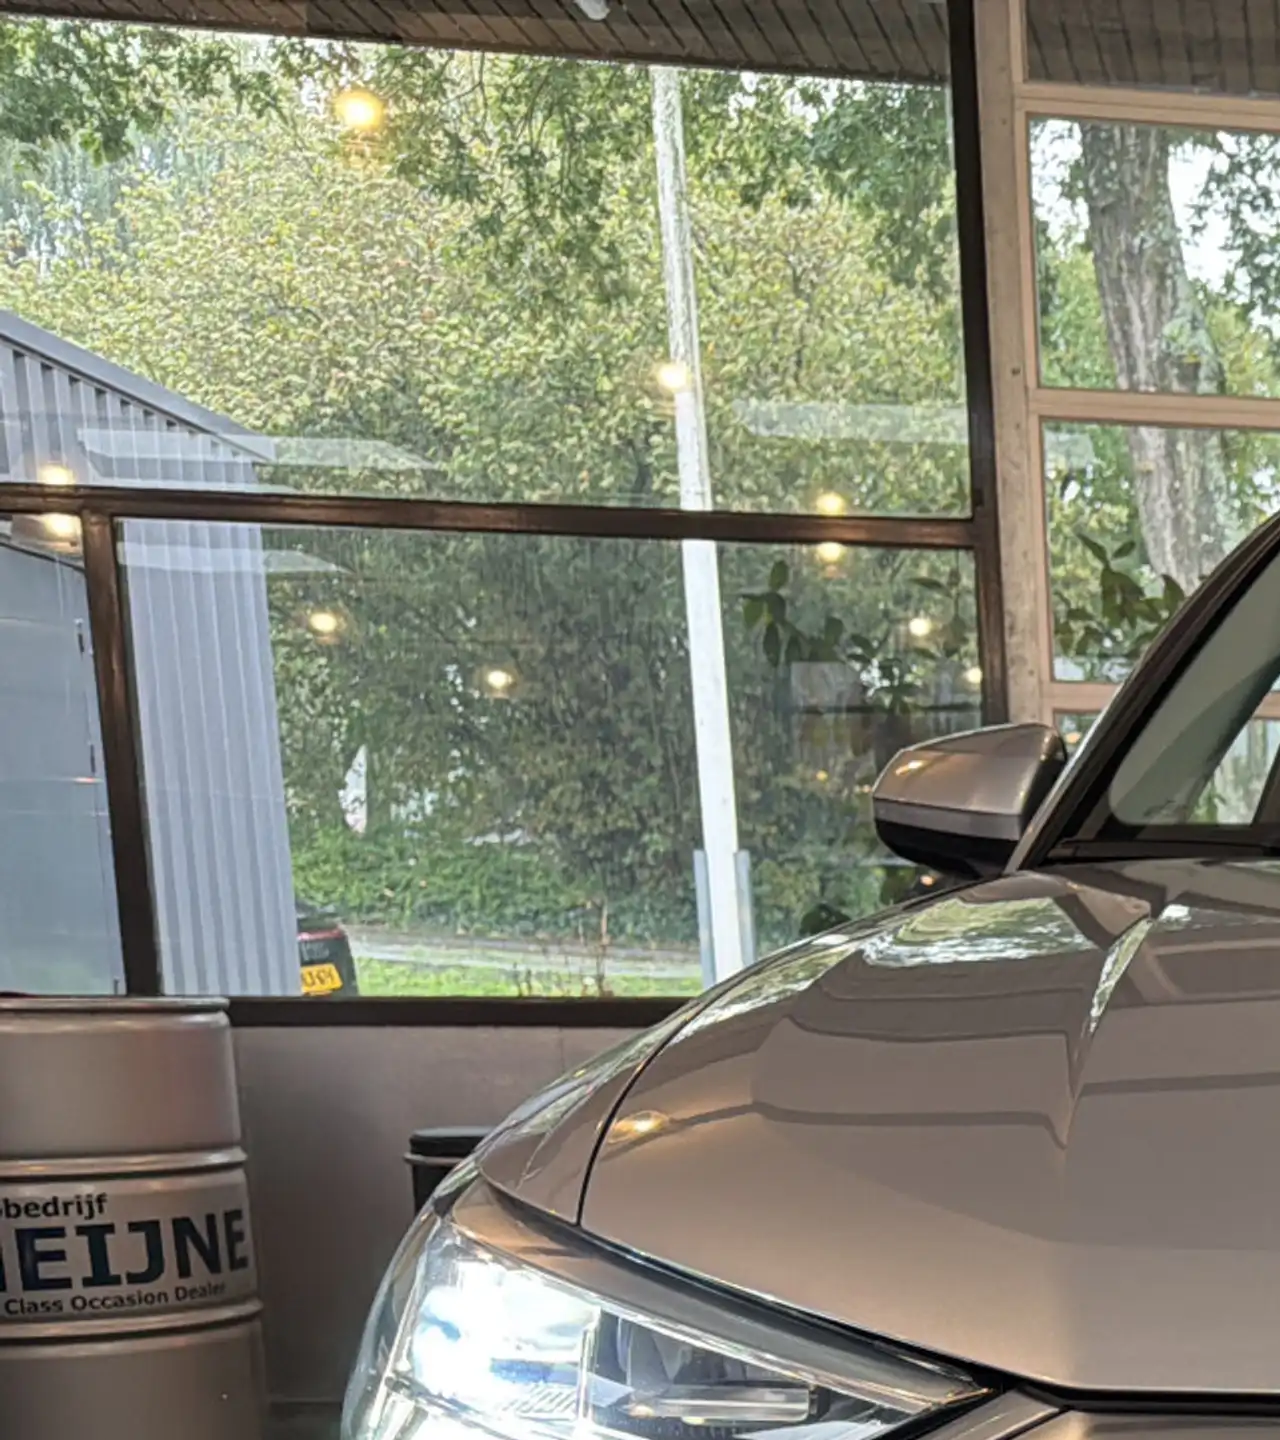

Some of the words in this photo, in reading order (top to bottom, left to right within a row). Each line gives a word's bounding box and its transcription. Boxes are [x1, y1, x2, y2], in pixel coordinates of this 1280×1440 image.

[4, 1299, 64, 1315] Class
[70, 1290, 169, 1311] Occasion
[175, 1282, 226, 1301] Dealer
